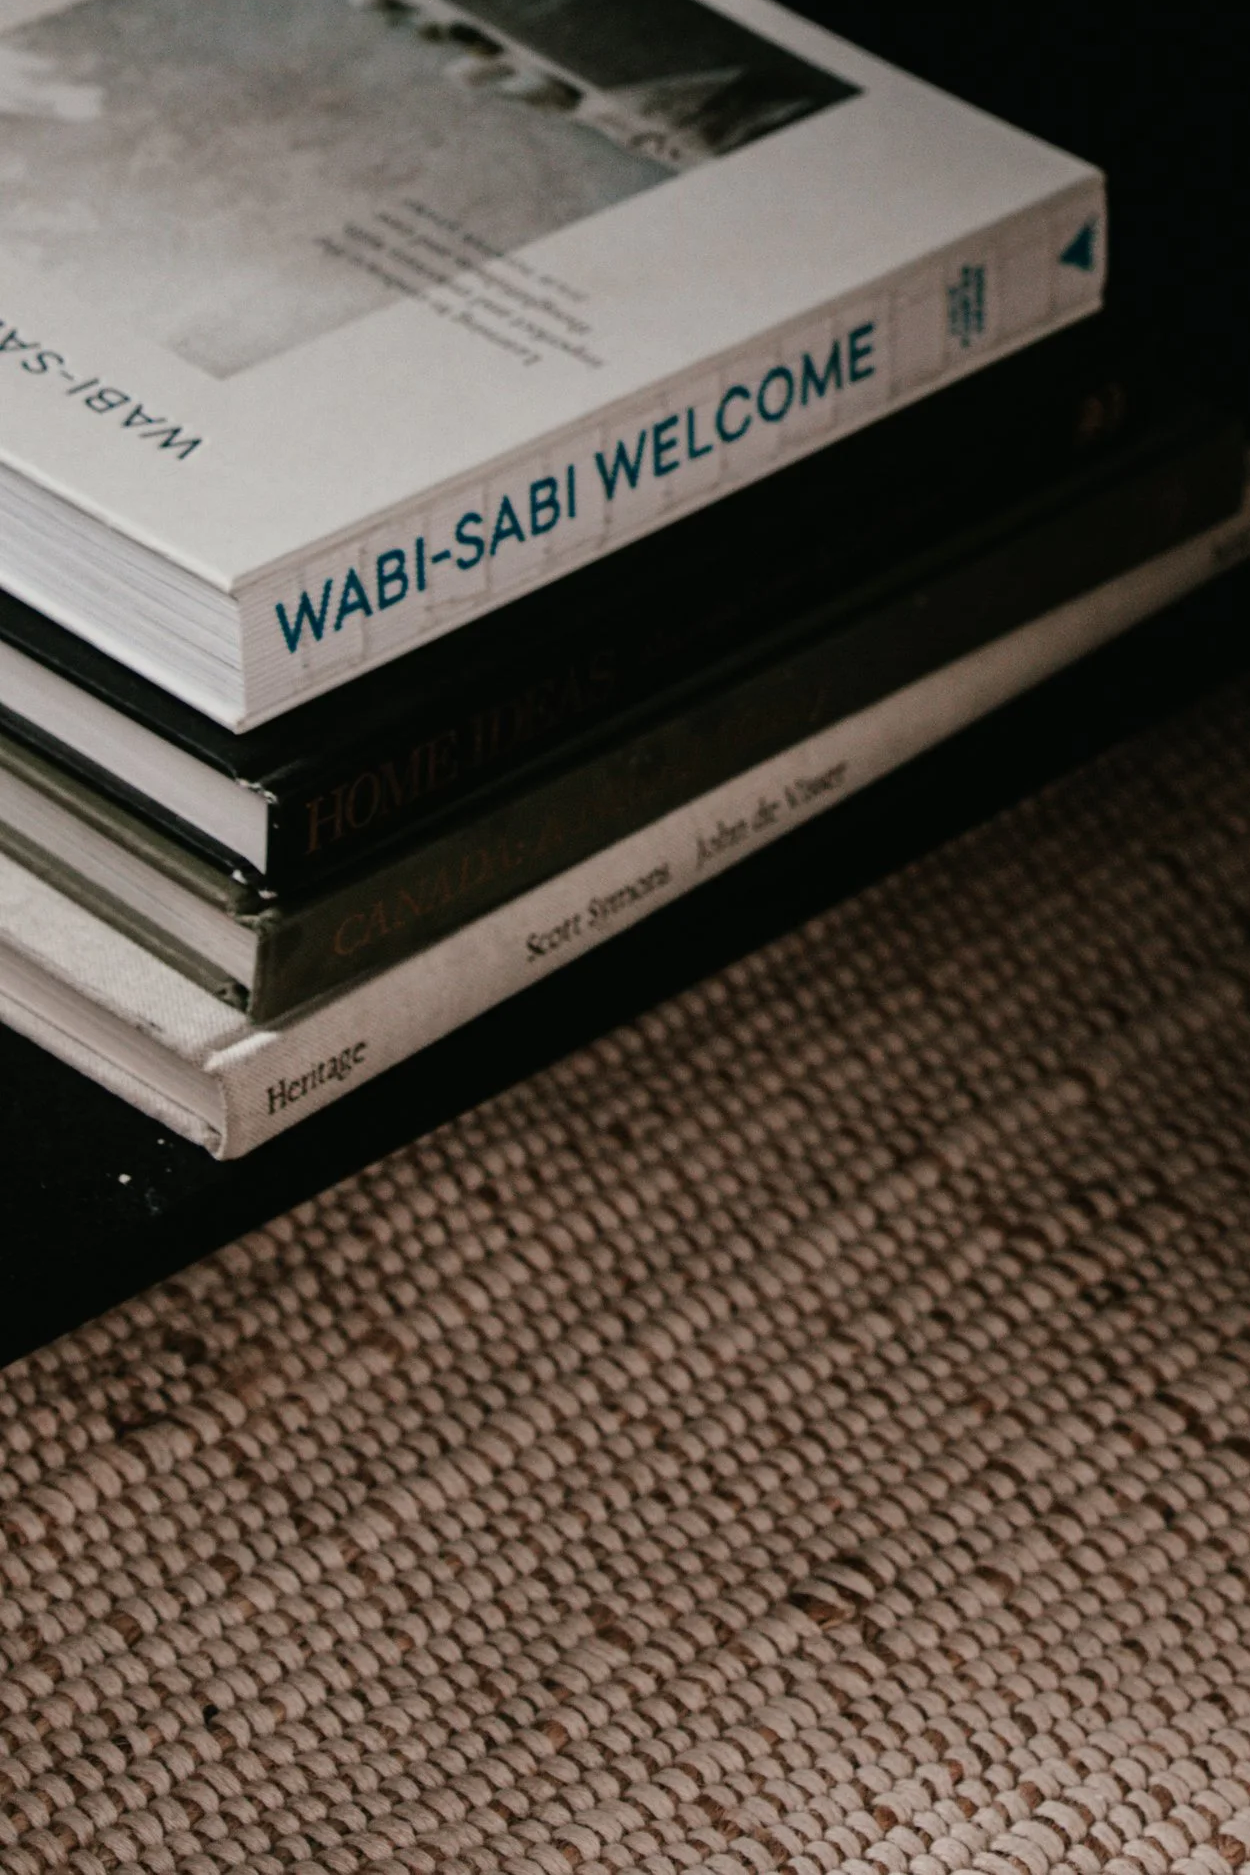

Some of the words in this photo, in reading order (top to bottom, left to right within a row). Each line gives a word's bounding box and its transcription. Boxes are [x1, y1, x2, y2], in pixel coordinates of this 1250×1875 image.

[0, 319, 203, 462] WABI-SA
[274, 464, 577, 654] WABI-SABI
[594, 322, 876, 501] WELCOME
[303, 728, 461, 857] HOME
[468, 647, 618, 770] IDEAS
[265, 1040, 367, 1106] Heritage
[525, 912, 583, 964] Scott
